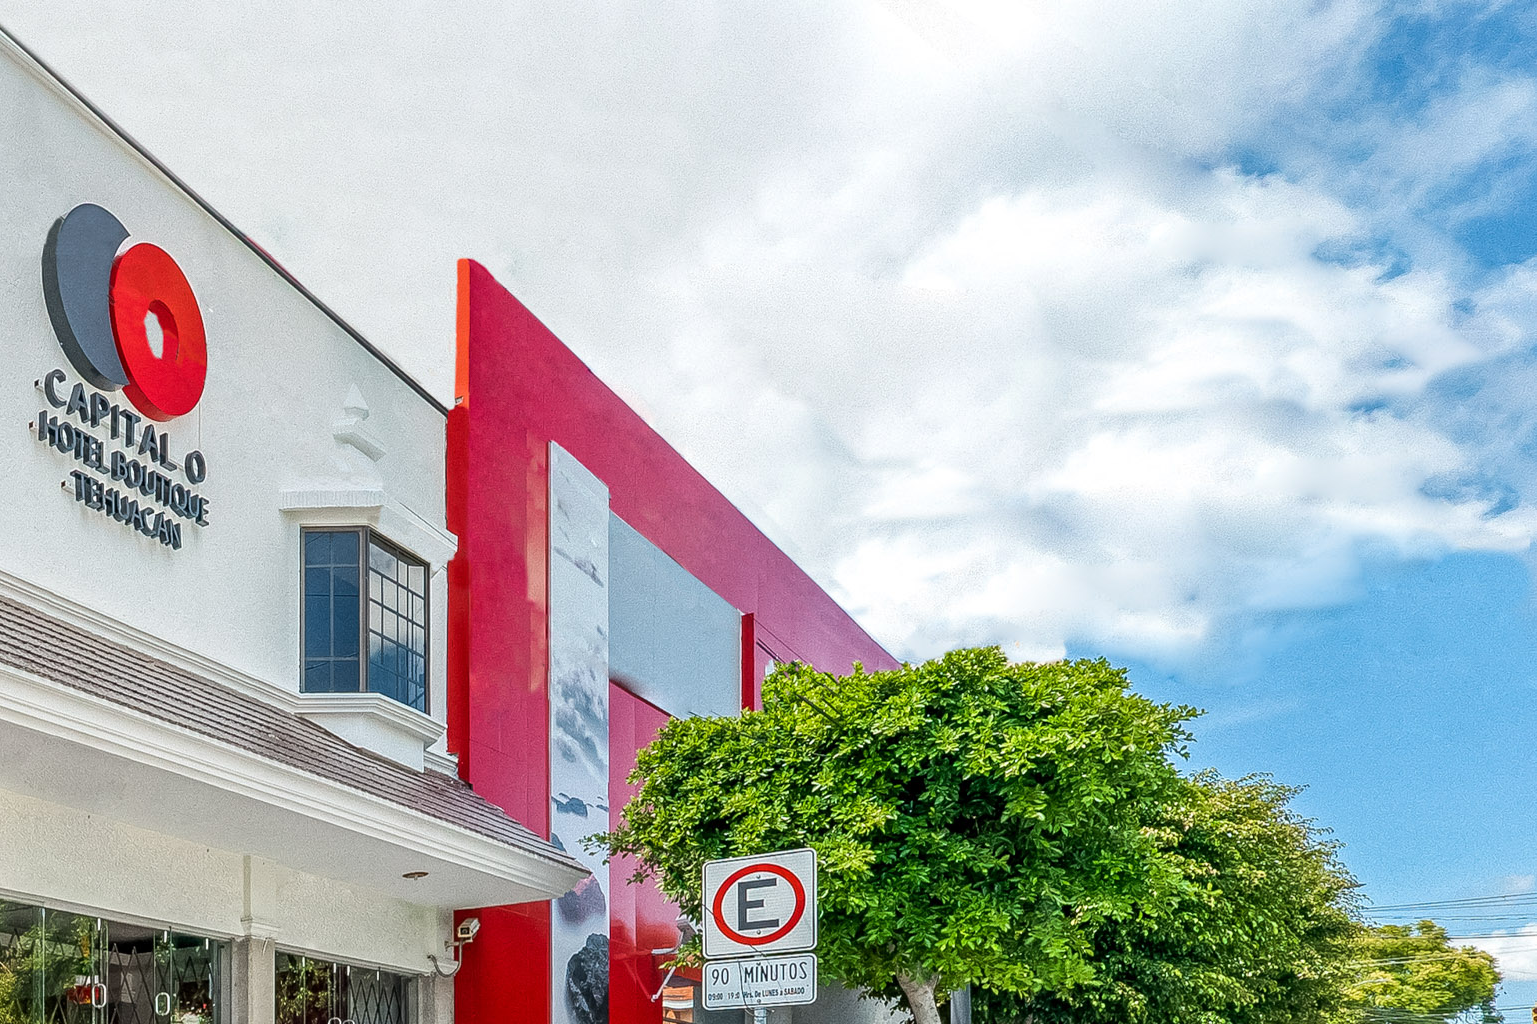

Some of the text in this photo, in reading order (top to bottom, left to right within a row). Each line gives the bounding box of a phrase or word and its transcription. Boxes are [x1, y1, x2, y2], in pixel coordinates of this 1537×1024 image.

[44, 369, 206, 485] CAPITAL O
[39, 410, 209, 527] HOTEL BOUTIQUE
[70, 470, 181, 550] TEHUACAN
[738, 878, 779, 931] E
[711, 962, 807, 985] 90 MINUTOS
[762, 989, 778, 997] LUNES
[784, 987, 805, 995] SABADO
